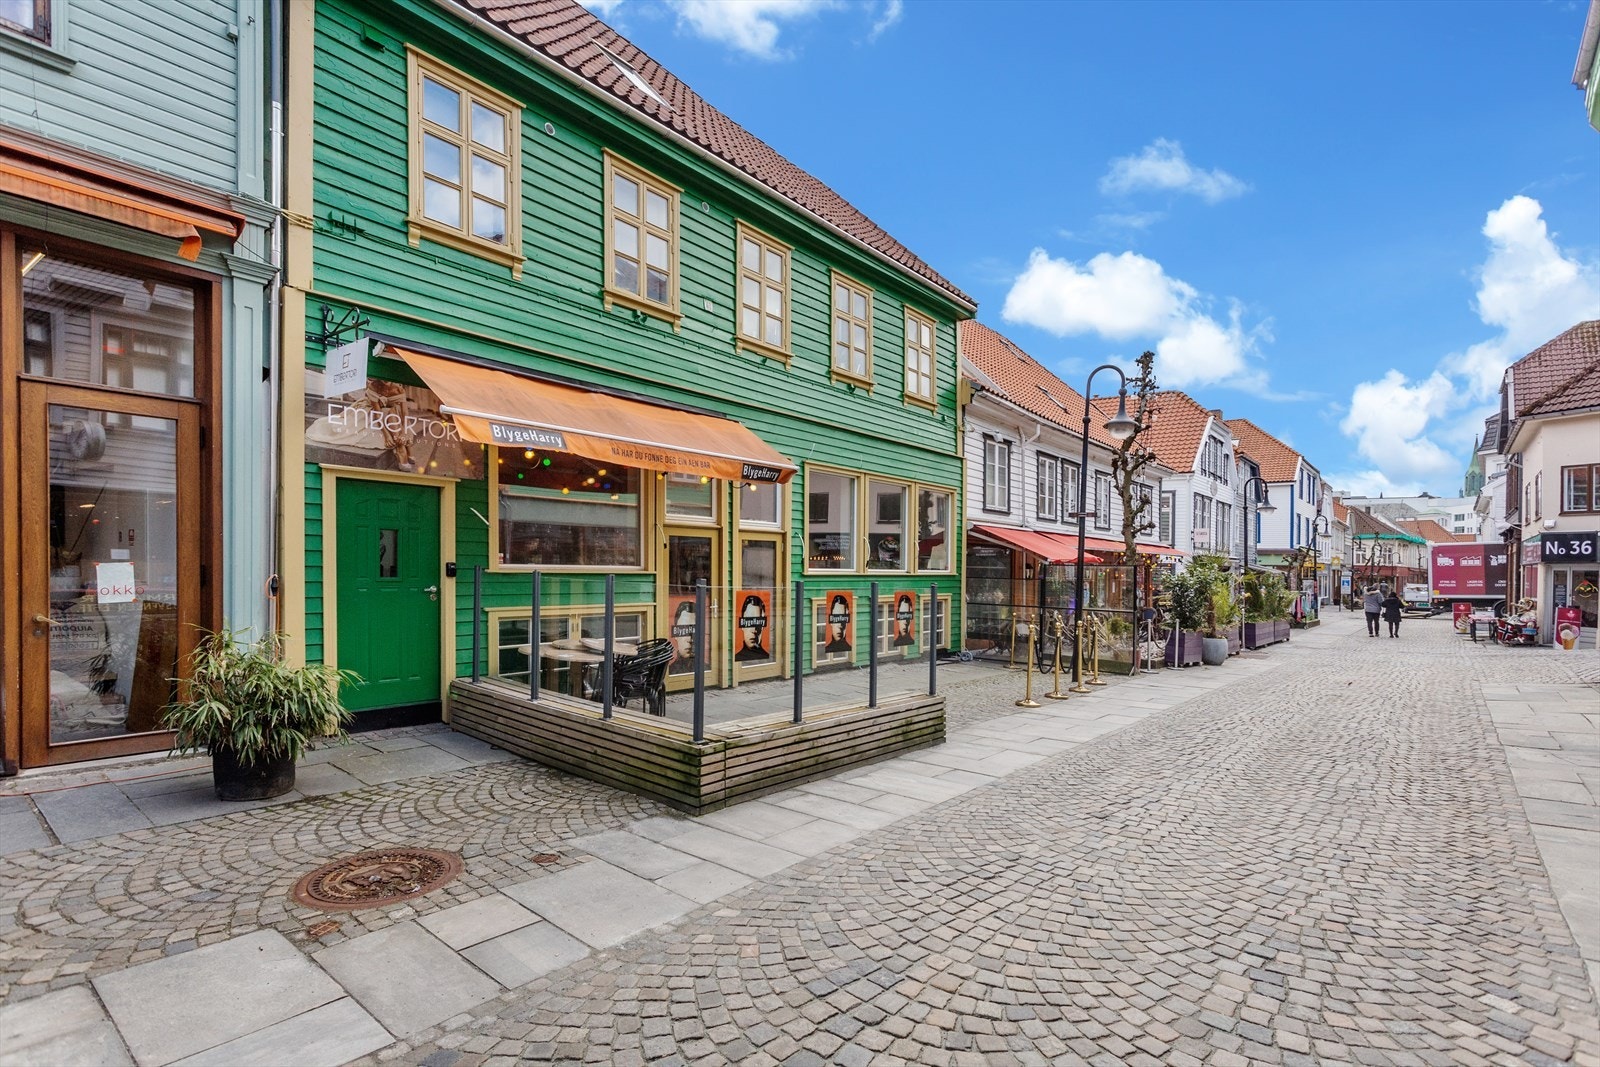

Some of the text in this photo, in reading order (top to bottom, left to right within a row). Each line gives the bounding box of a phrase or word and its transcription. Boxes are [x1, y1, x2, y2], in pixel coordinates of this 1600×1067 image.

[327, 403, 463, 442] EMBERTOR
[393, 435, 456, 449] SOLUTIONS
[492, 424, 562, 447] BlygeHarry
[621, 449, 634, 459] HAR
[665, 455, 677, 465] DEG
[700, 461, 711, 469] BAR
[743, 465, 779, 481] BlygeHarry
[1569, 540, 1592, 555] 36
[740, 617, 766, 627] BlygeHarry
[673, 626, 696, 635] BlygeHa
